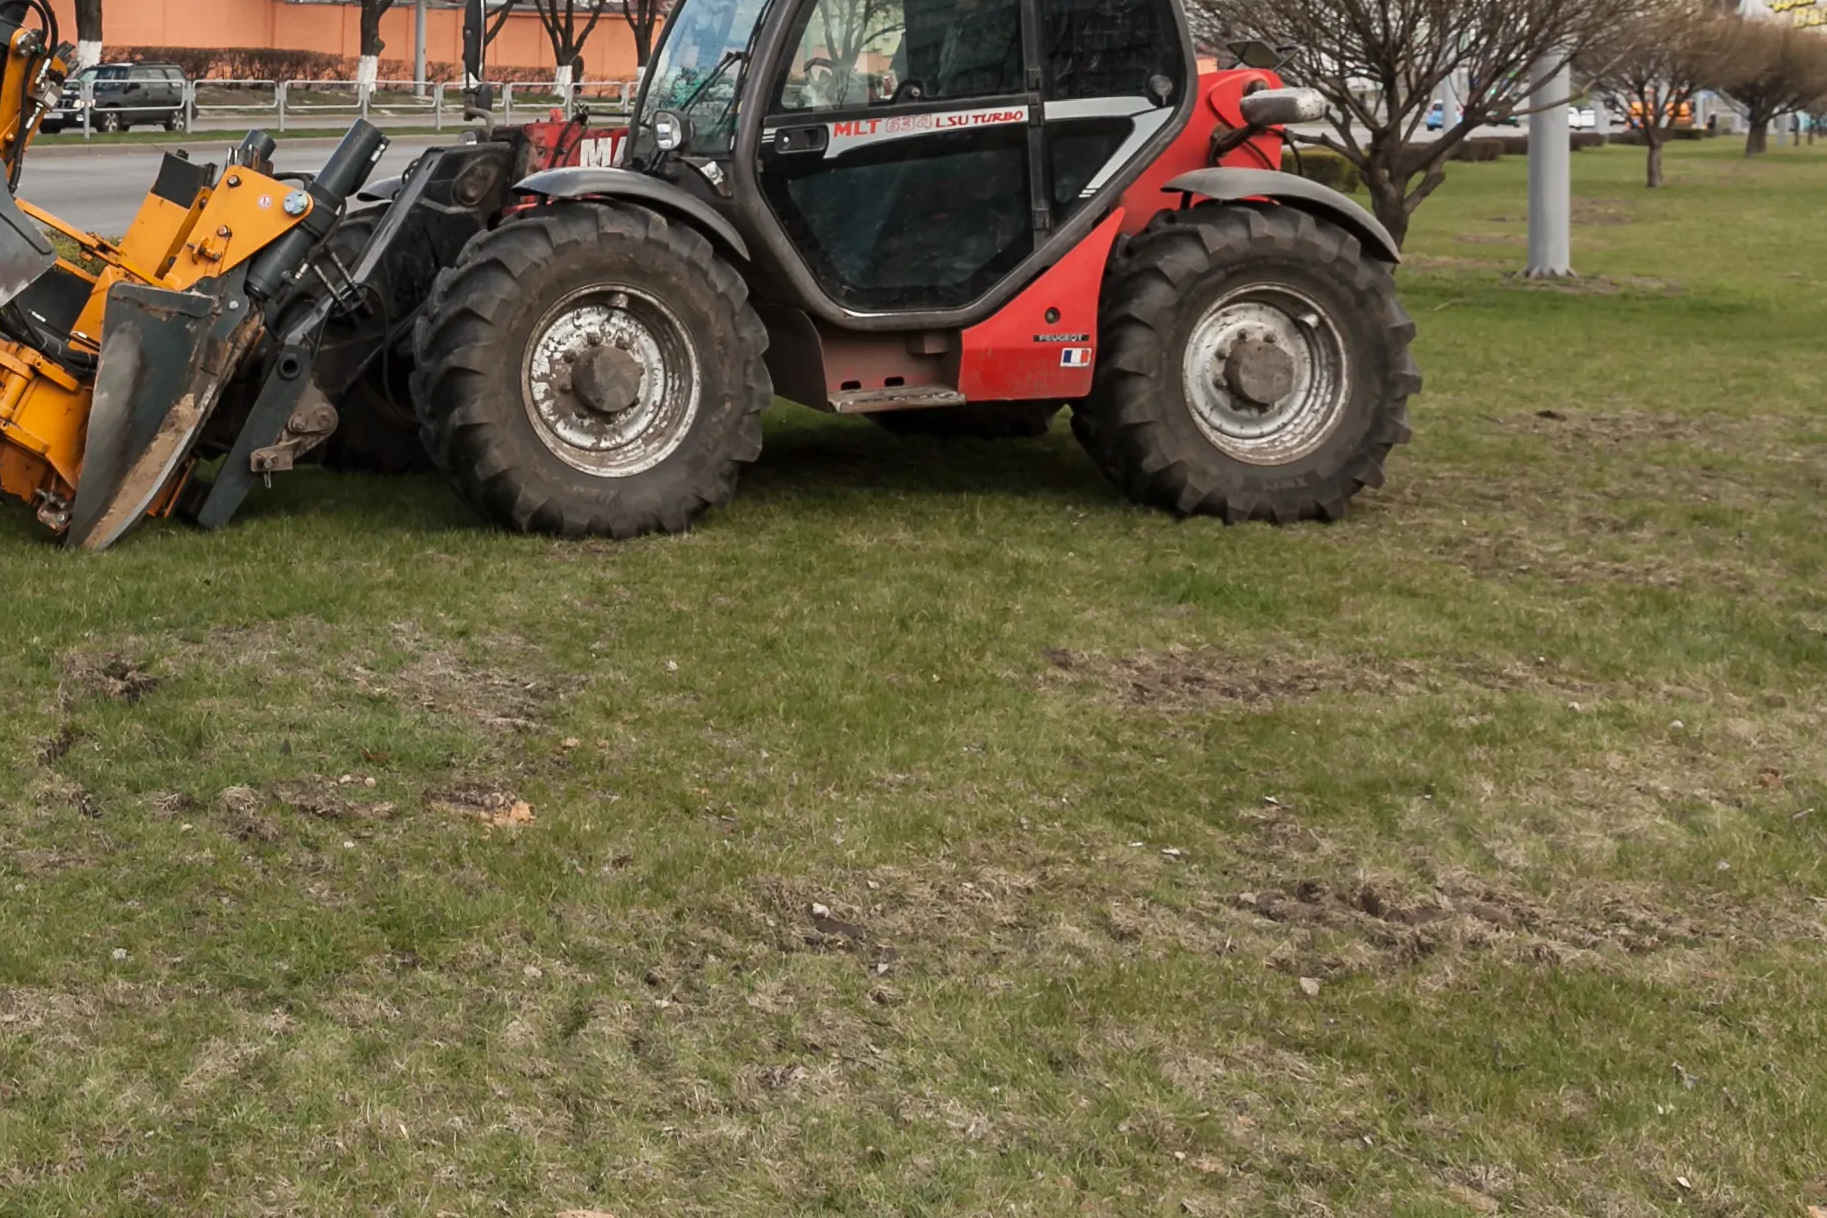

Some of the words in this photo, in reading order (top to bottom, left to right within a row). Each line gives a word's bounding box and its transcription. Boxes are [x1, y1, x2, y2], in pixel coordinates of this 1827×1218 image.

[833, 119, 882, 138] MLT
[885, 113, 933, 133] 634
[972, 110, 1023, 123] TURBO
[1039, 334, 1083, 342] PEUGEOT
